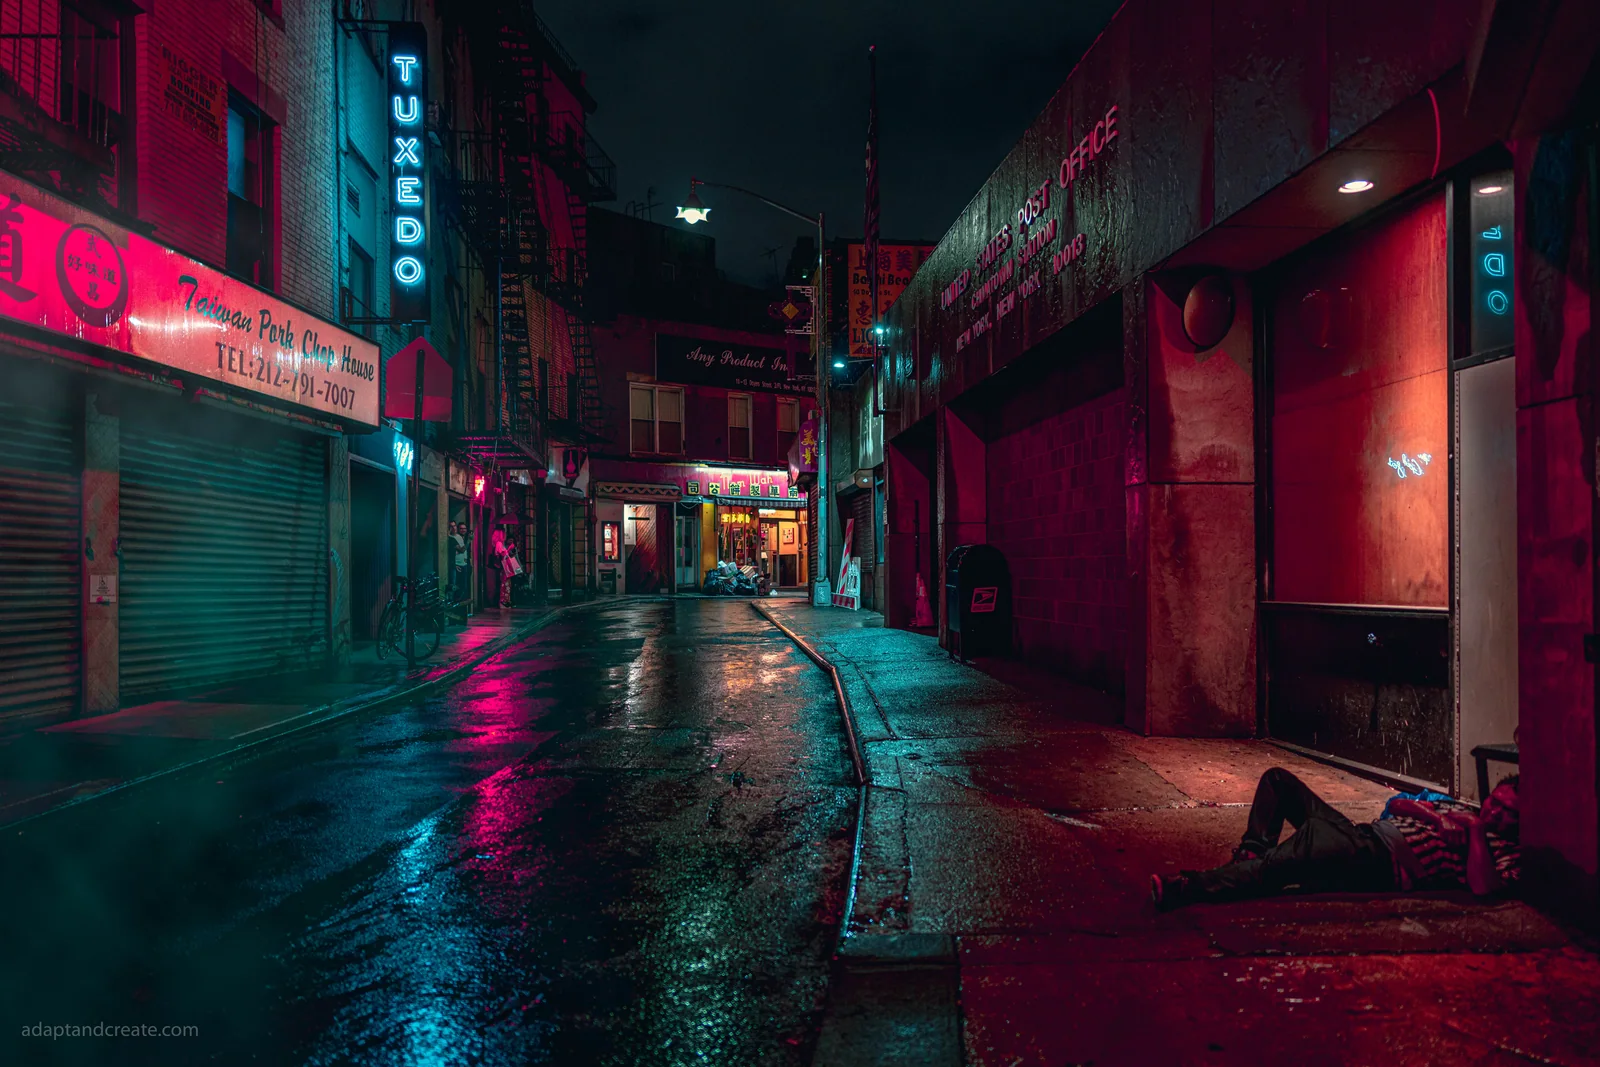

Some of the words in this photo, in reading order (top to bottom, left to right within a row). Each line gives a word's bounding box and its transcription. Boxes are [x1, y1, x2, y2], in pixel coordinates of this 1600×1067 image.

[392, 54, 423, 287] TUXEDO
[940, 268, 972, 310] UNITED
[975, 223, 1012, 277] STATES
[1017, 179, 1053, 234] POST
[1059, 103, 1119, 189] OFFICE
[955, 327, 972, 353] NEW
[996, 290, 1016, 321] NEW
[1018, 271, 1042, 300] YORK
[1053, 233, 1087, 275] 10013
[970, 258, 1015, 310] CHINATOWN
[1017, 219, 1057, 268] STATION
[178, 274, 253, 333] Taiwan
[259, 309, 295, 350] Pork
[302, 329, 335, 372] Chop
[341, 345, 375, 382] House
[686, 346, 716, 367] Any
[720, 350, 766, 369] Product
[750, 473, 774, 486] Wah
